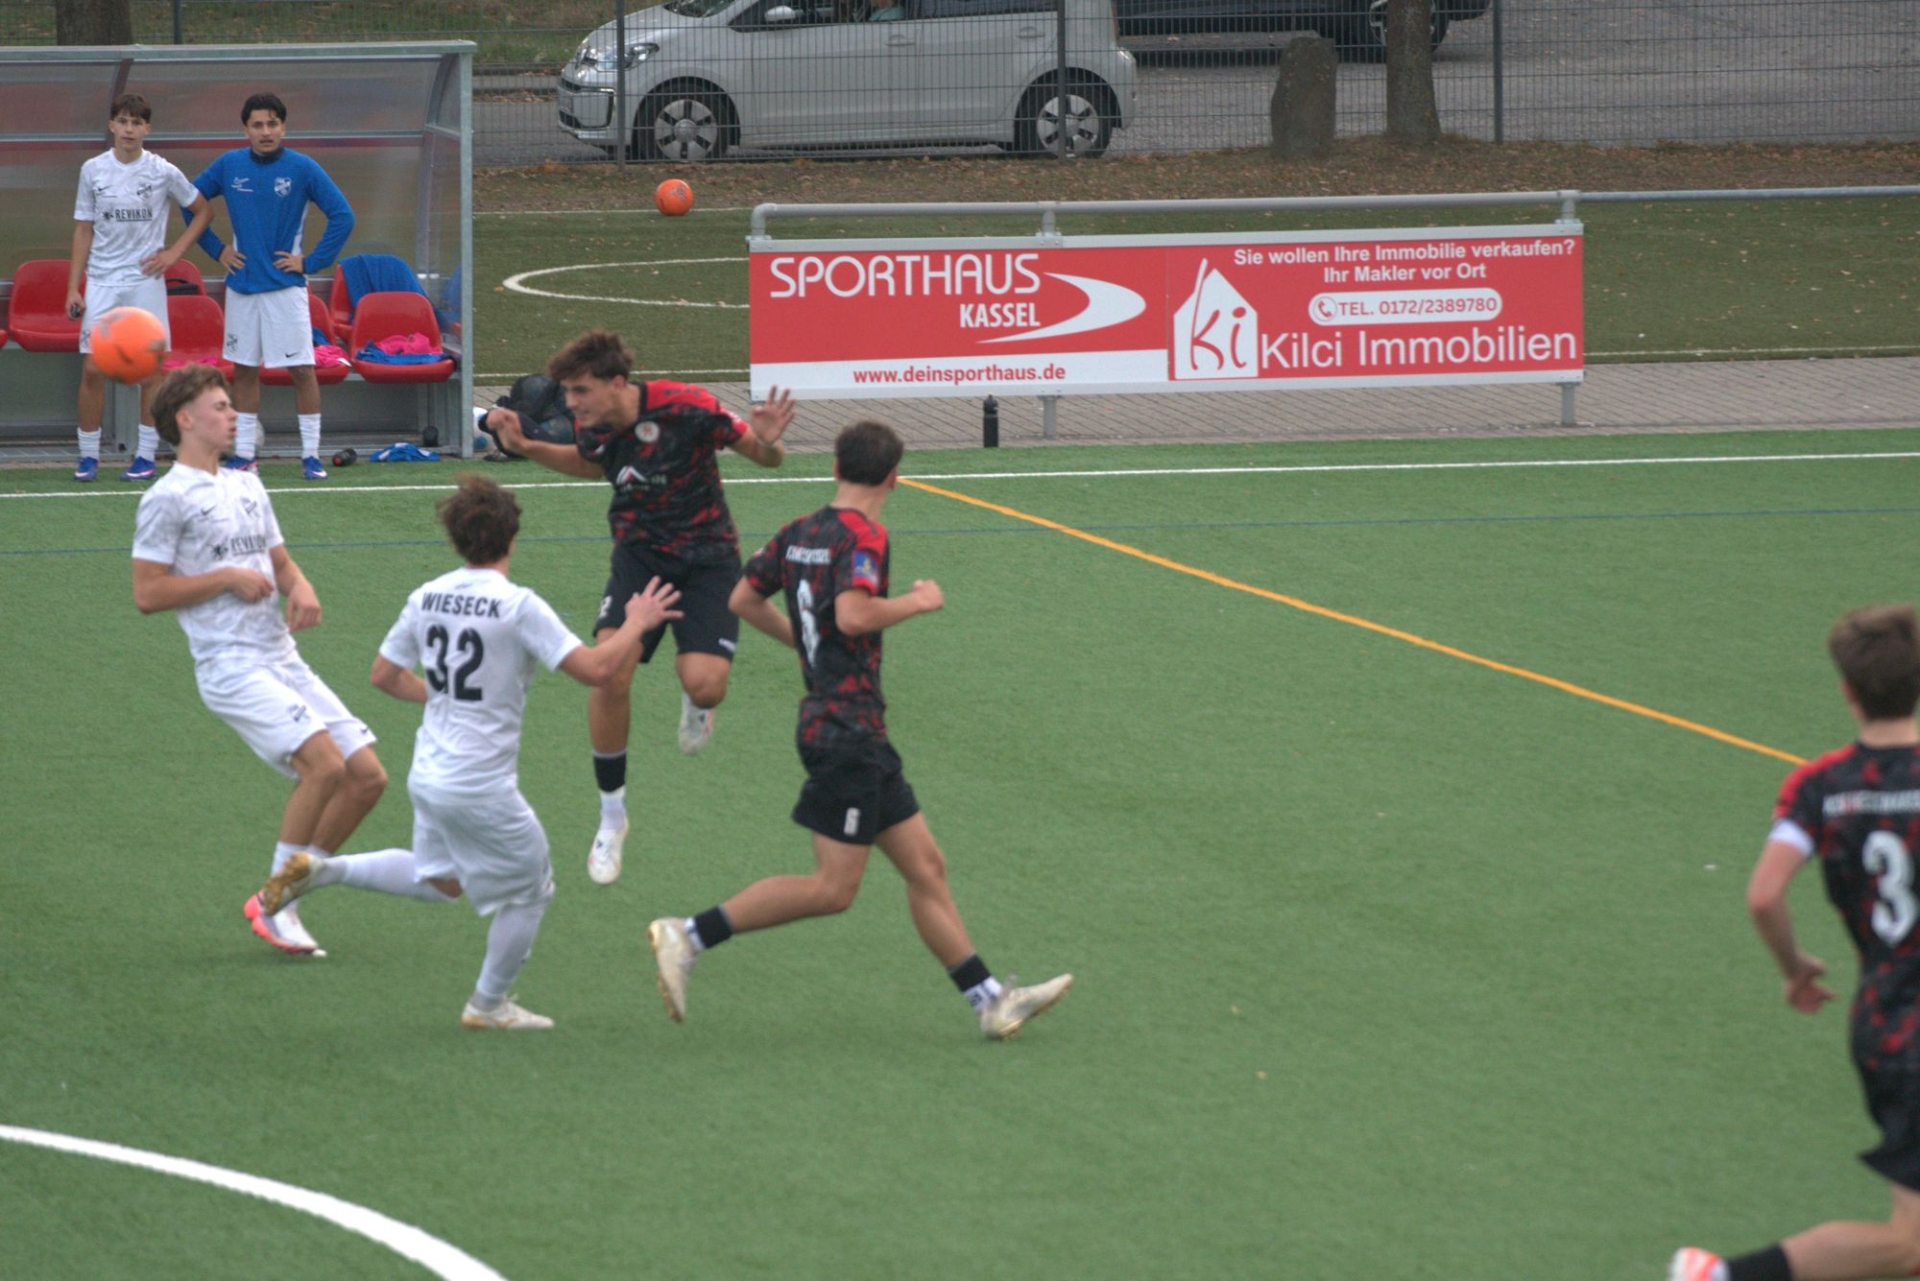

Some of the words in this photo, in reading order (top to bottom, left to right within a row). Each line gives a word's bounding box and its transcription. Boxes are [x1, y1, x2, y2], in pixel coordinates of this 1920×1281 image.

[1233, 249, 1263, 266] Sie
[1268, 248, 1329, 265] wollen
[1335, 246, 1371, 262] Ihre
[1375, 243, 1466, 261] Immobilie
[1471, 239, 1576, 258] verkaufen?
[770, 253, 1041, 298] SPORTHAUS
[1324, 267, 1350, 284] Ihr
[1355, 264, 1416, 282] Makler
[1421, 267, 1452, 280] vor
[1457, 263, 1487, 280] Ort
[959, 302, 1041, 328] KASSEL
[1338, 302, 1374, 317] TEL.
[1379, 297, 1498, 317] 0172/2389780
[1261, 332, 1343, 369] Kilci
[1359, 326, 1577, 366] Immobilien
[853, 364, 1066, 386] www.deinsporthaus.de
[421, 592, 501, 618] WIESECK
[425, 623, 484, 702] 32
[1862, 830, 1914, 948] 3
